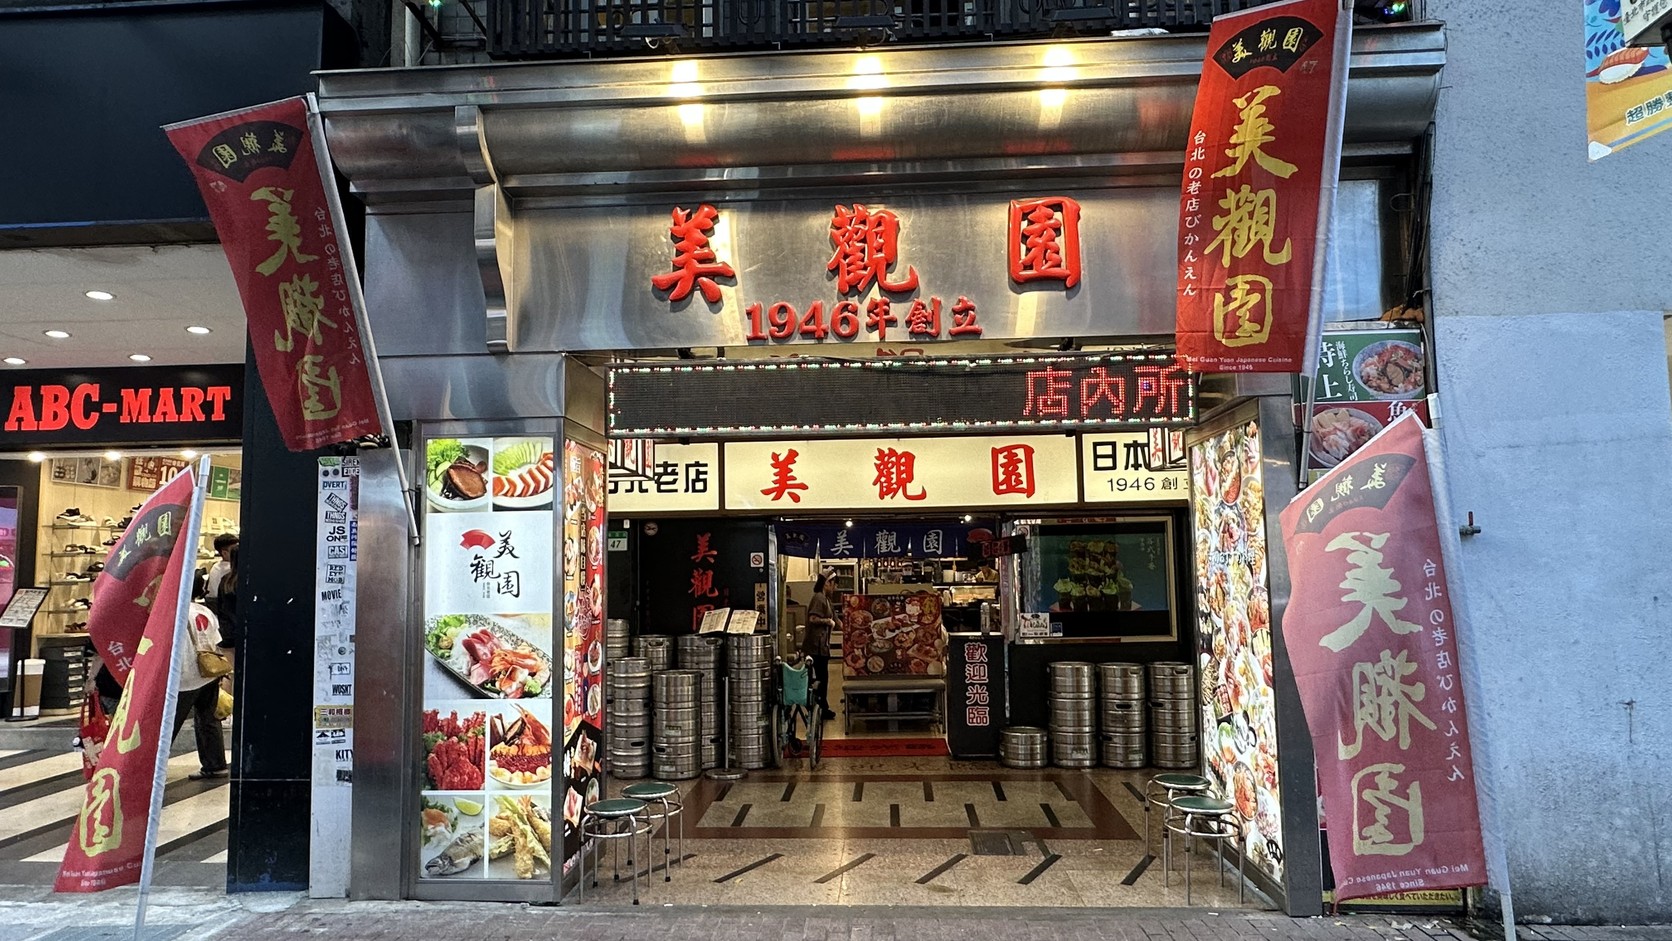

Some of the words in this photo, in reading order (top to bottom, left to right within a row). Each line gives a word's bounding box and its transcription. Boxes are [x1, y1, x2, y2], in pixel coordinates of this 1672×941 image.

[1204, 85, 1298, 347] 美觀園
[651, 197, 1082, 302] 美觀園
[745, 296, 984, 341] 1946年創立
[4, 384, 231, 432] ABC-MART
[761, 443, 1038, 503] 美觀園
[610, 539, 622, 549] 47
[831, 529, 944, 556] 美觀園
[965, 642, 990, 728] 歡迎光臨
